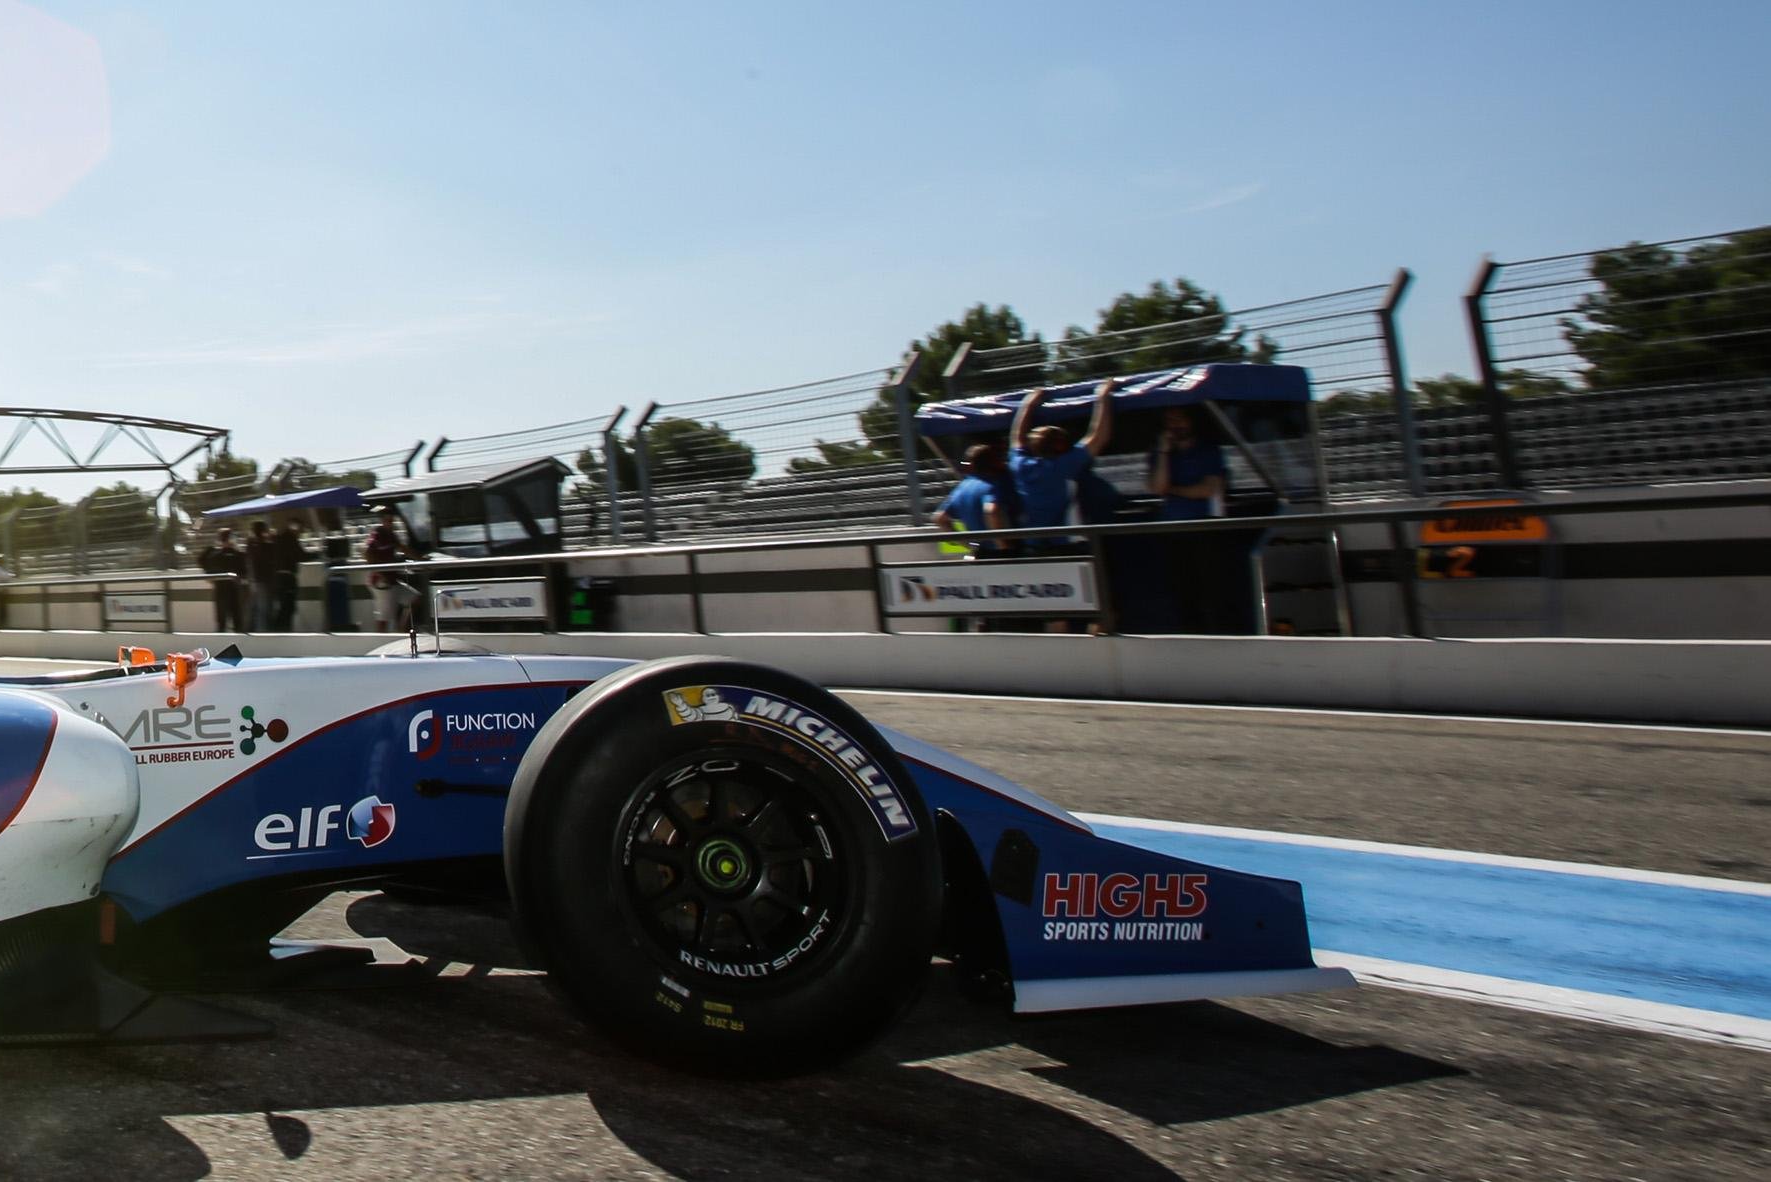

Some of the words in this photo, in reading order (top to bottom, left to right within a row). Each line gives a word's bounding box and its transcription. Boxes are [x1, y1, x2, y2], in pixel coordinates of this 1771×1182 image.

[446, 713, 535, 731] FUNCTION
[149, 751, 191, 764] RUBBER
[192, 749, 235, 761] EUROPE
[745, 694, 912, 832] MICHELIN
[253, 804, 342, 851] elf
[1043, 872, 1208, 918] HIGH5
[680, 949, 769, 978] RENAULT
[772, 909, 830, 972] SPORT
[1043, 922, 1110, 941] SPORTS
[1114, 922, 1203, 941] NUTRITION
